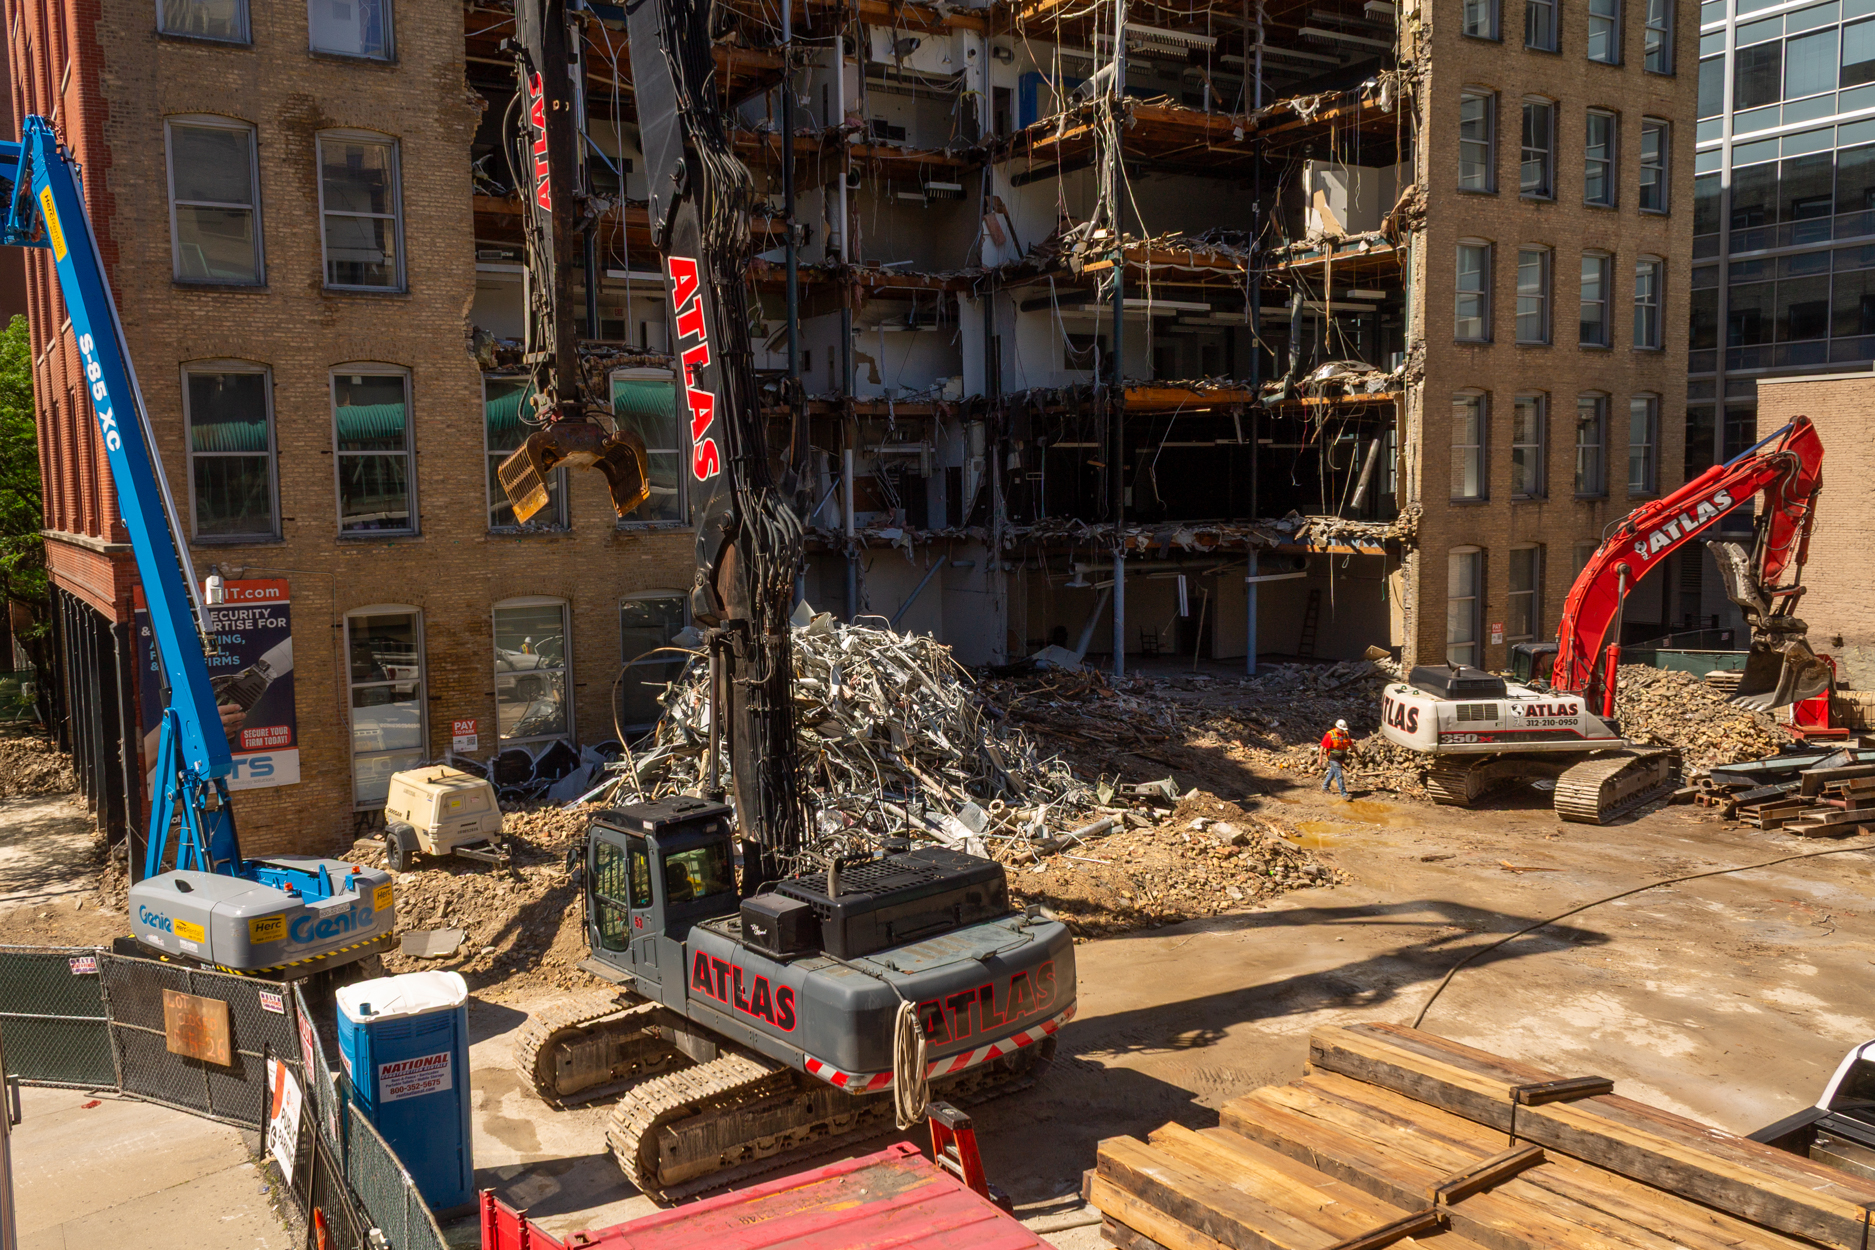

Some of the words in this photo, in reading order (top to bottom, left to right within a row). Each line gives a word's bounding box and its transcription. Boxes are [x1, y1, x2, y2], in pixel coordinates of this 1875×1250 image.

[528, 71, 552, 212] ATLAS
[668, 256, 720, 482] ATLAS
[79, 333, 107, 401] S-85
[98, 406, 121, 452] XC
[1650, 488, 1735, 555] ATLAS
[210, 608, 271, 622] ECURITY
[258, 617, 287, 629] FOR
[1383, 694, 1420, 734] TLAS
[1525, 703, 1579, 717] ATLAS
[454, 720, 475, 730] PAY
[1526, 718, 1579, 727] 312-210-0950
[244, 728, 269, 738] SECURE
[270, 726, 288, 736] YOUR
[245, 737, 263, 747] FIRM
[264, 735, 288, 745] TODAY!
[230, 755, 275, 780] TS
[376, 888, 391, 901] Herc
[139, 904, 173, 934] Genie
[255, 921, 282, 933] Herc
[290, 904, 374, 945] Genie
[634, 915, 644, 930] 53
[166, 991, 190, 1009] LOT
[260, 992, 281, 1002] DELTA
[690, 949, 797, 1033] ATLAS
[915, 960, 1059, 1048] ATLAS
[178, 1013, 218, 1031] CLOSED
[173, 1028, 226, 1061] 5-5-26
[381, 1053, 449, 1075] NATIONAL
[390, 1079, 441, 1095] 800-352-5675
